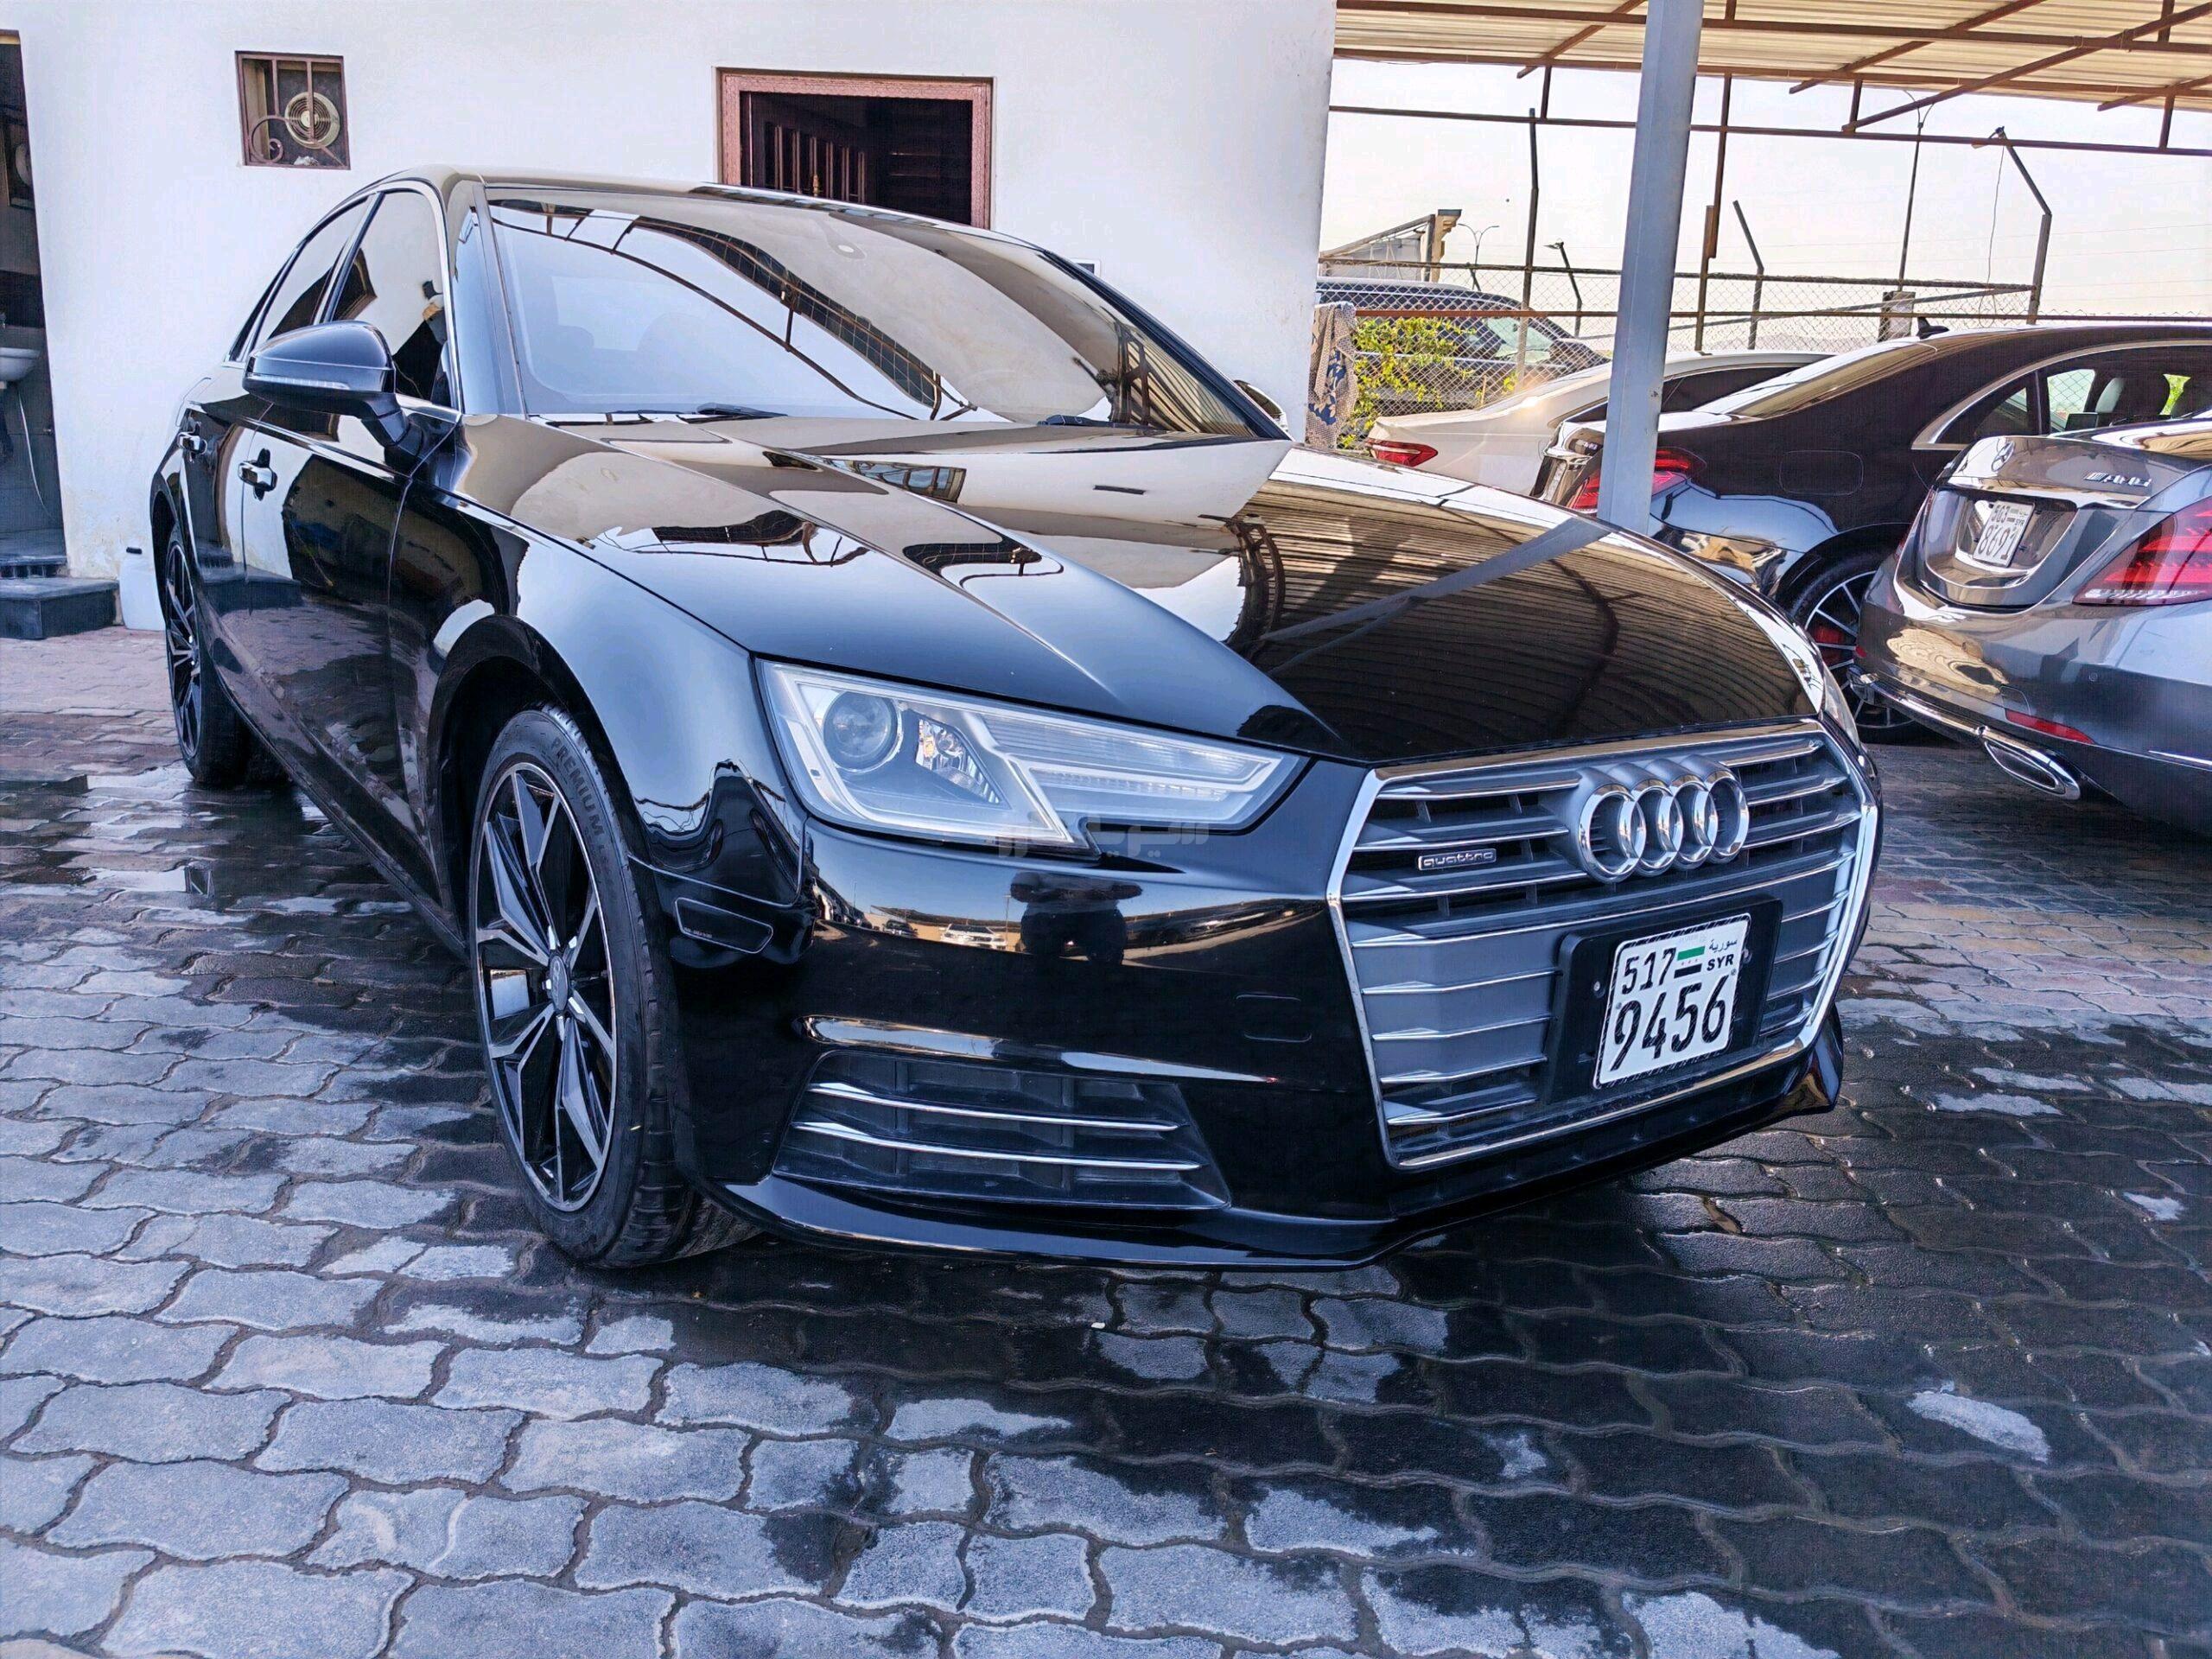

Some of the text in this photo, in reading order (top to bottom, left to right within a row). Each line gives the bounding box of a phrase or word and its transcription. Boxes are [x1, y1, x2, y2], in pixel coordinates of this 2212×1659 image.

[551, 737, 604, 836] PREMIUM
[1423, 851, 1494, 868] quattro
[1708, 938, 1738, 952] سورية
[1621, 947, 1677, 995] 517
[1707, 953, 1735, 972] SYR
[1610, 974, 1730, 1072] 9456
